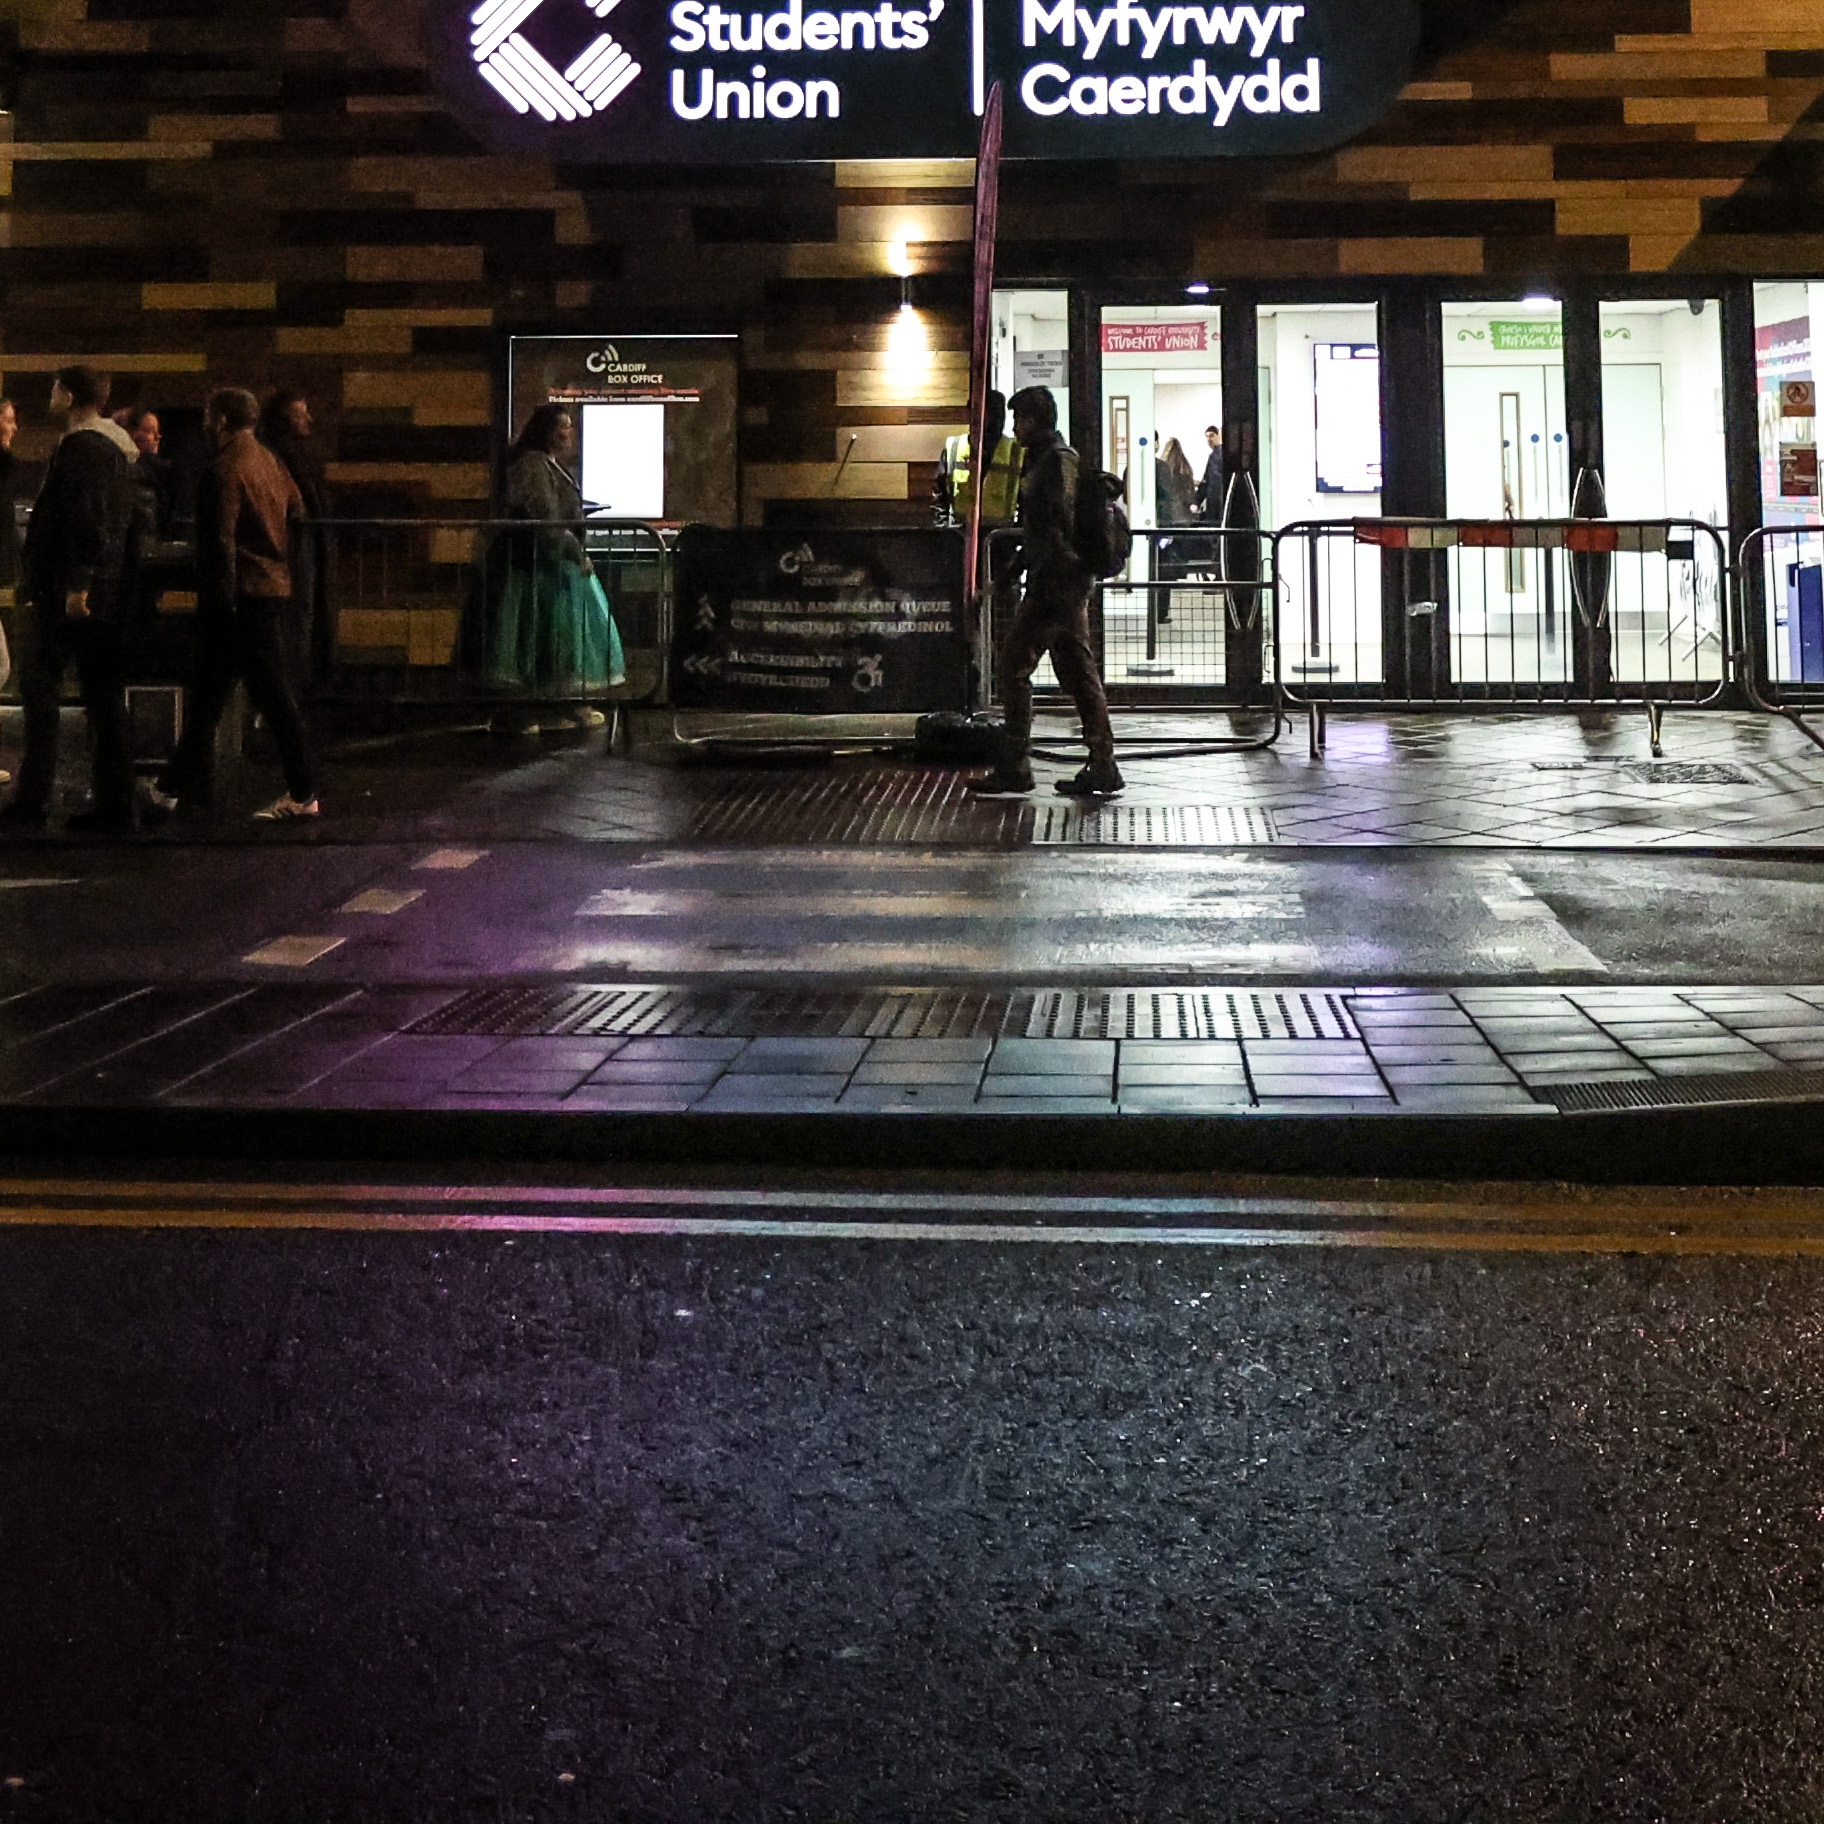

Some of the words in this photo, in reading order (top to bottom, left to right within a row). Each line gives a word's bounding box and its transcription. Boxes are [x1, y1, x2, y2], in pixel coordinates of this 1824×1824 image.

[672, 65, 839, 120] Union
[1021, 58, 1320, 126] Caerdydd
[1165, 334, 1199, 350] UNION
[607, 362, 648, 373] CARDIFF
[607, 374, 628, 384] BOX
[630, 374, 664, 384] OFFICE
[730, 599, 803, 613] GENERAL
[807, 600, 896, 614] ADMISSION
[900, 600, 952, 614] QUEUE
